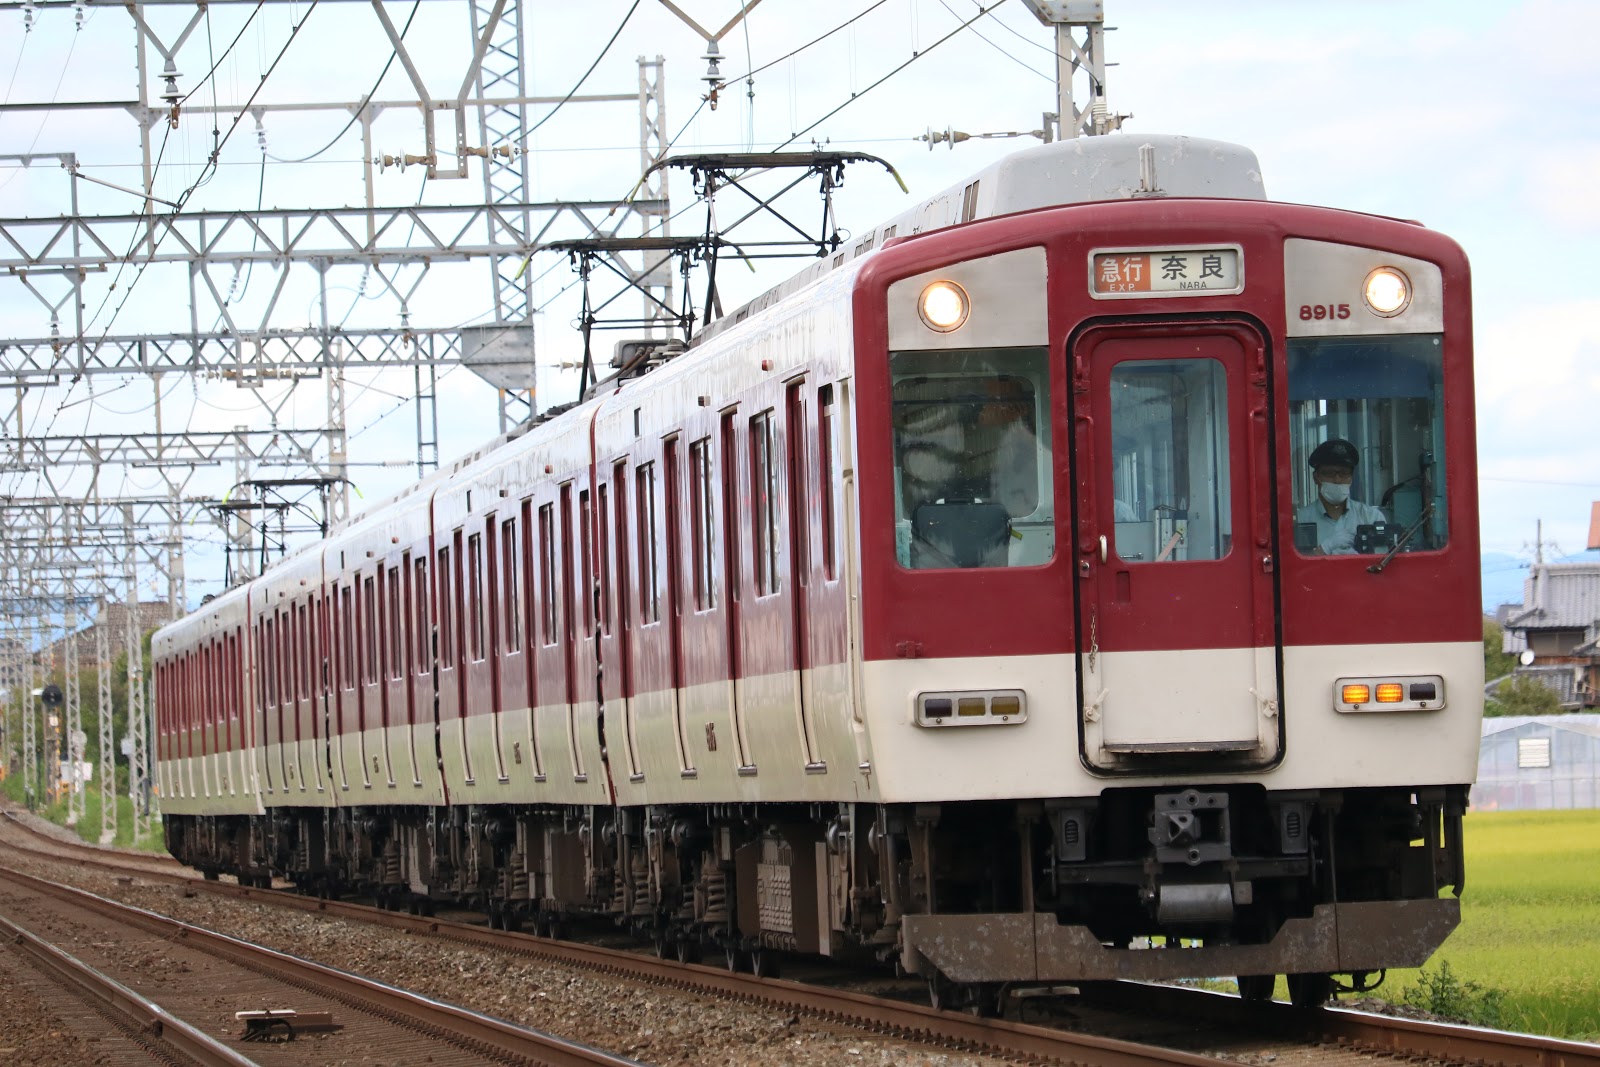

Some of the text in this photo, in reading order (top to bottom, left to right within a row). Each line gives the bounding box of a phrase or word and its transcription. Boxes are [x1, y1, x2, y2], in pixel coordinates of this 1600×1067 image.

[1101, 257, 1143, 283] 急行
[1161, 254, 1225, 281] 奈良
[1179, 281, 1208, 290] NARA
[1299, 303, 1351, 321] 8915
